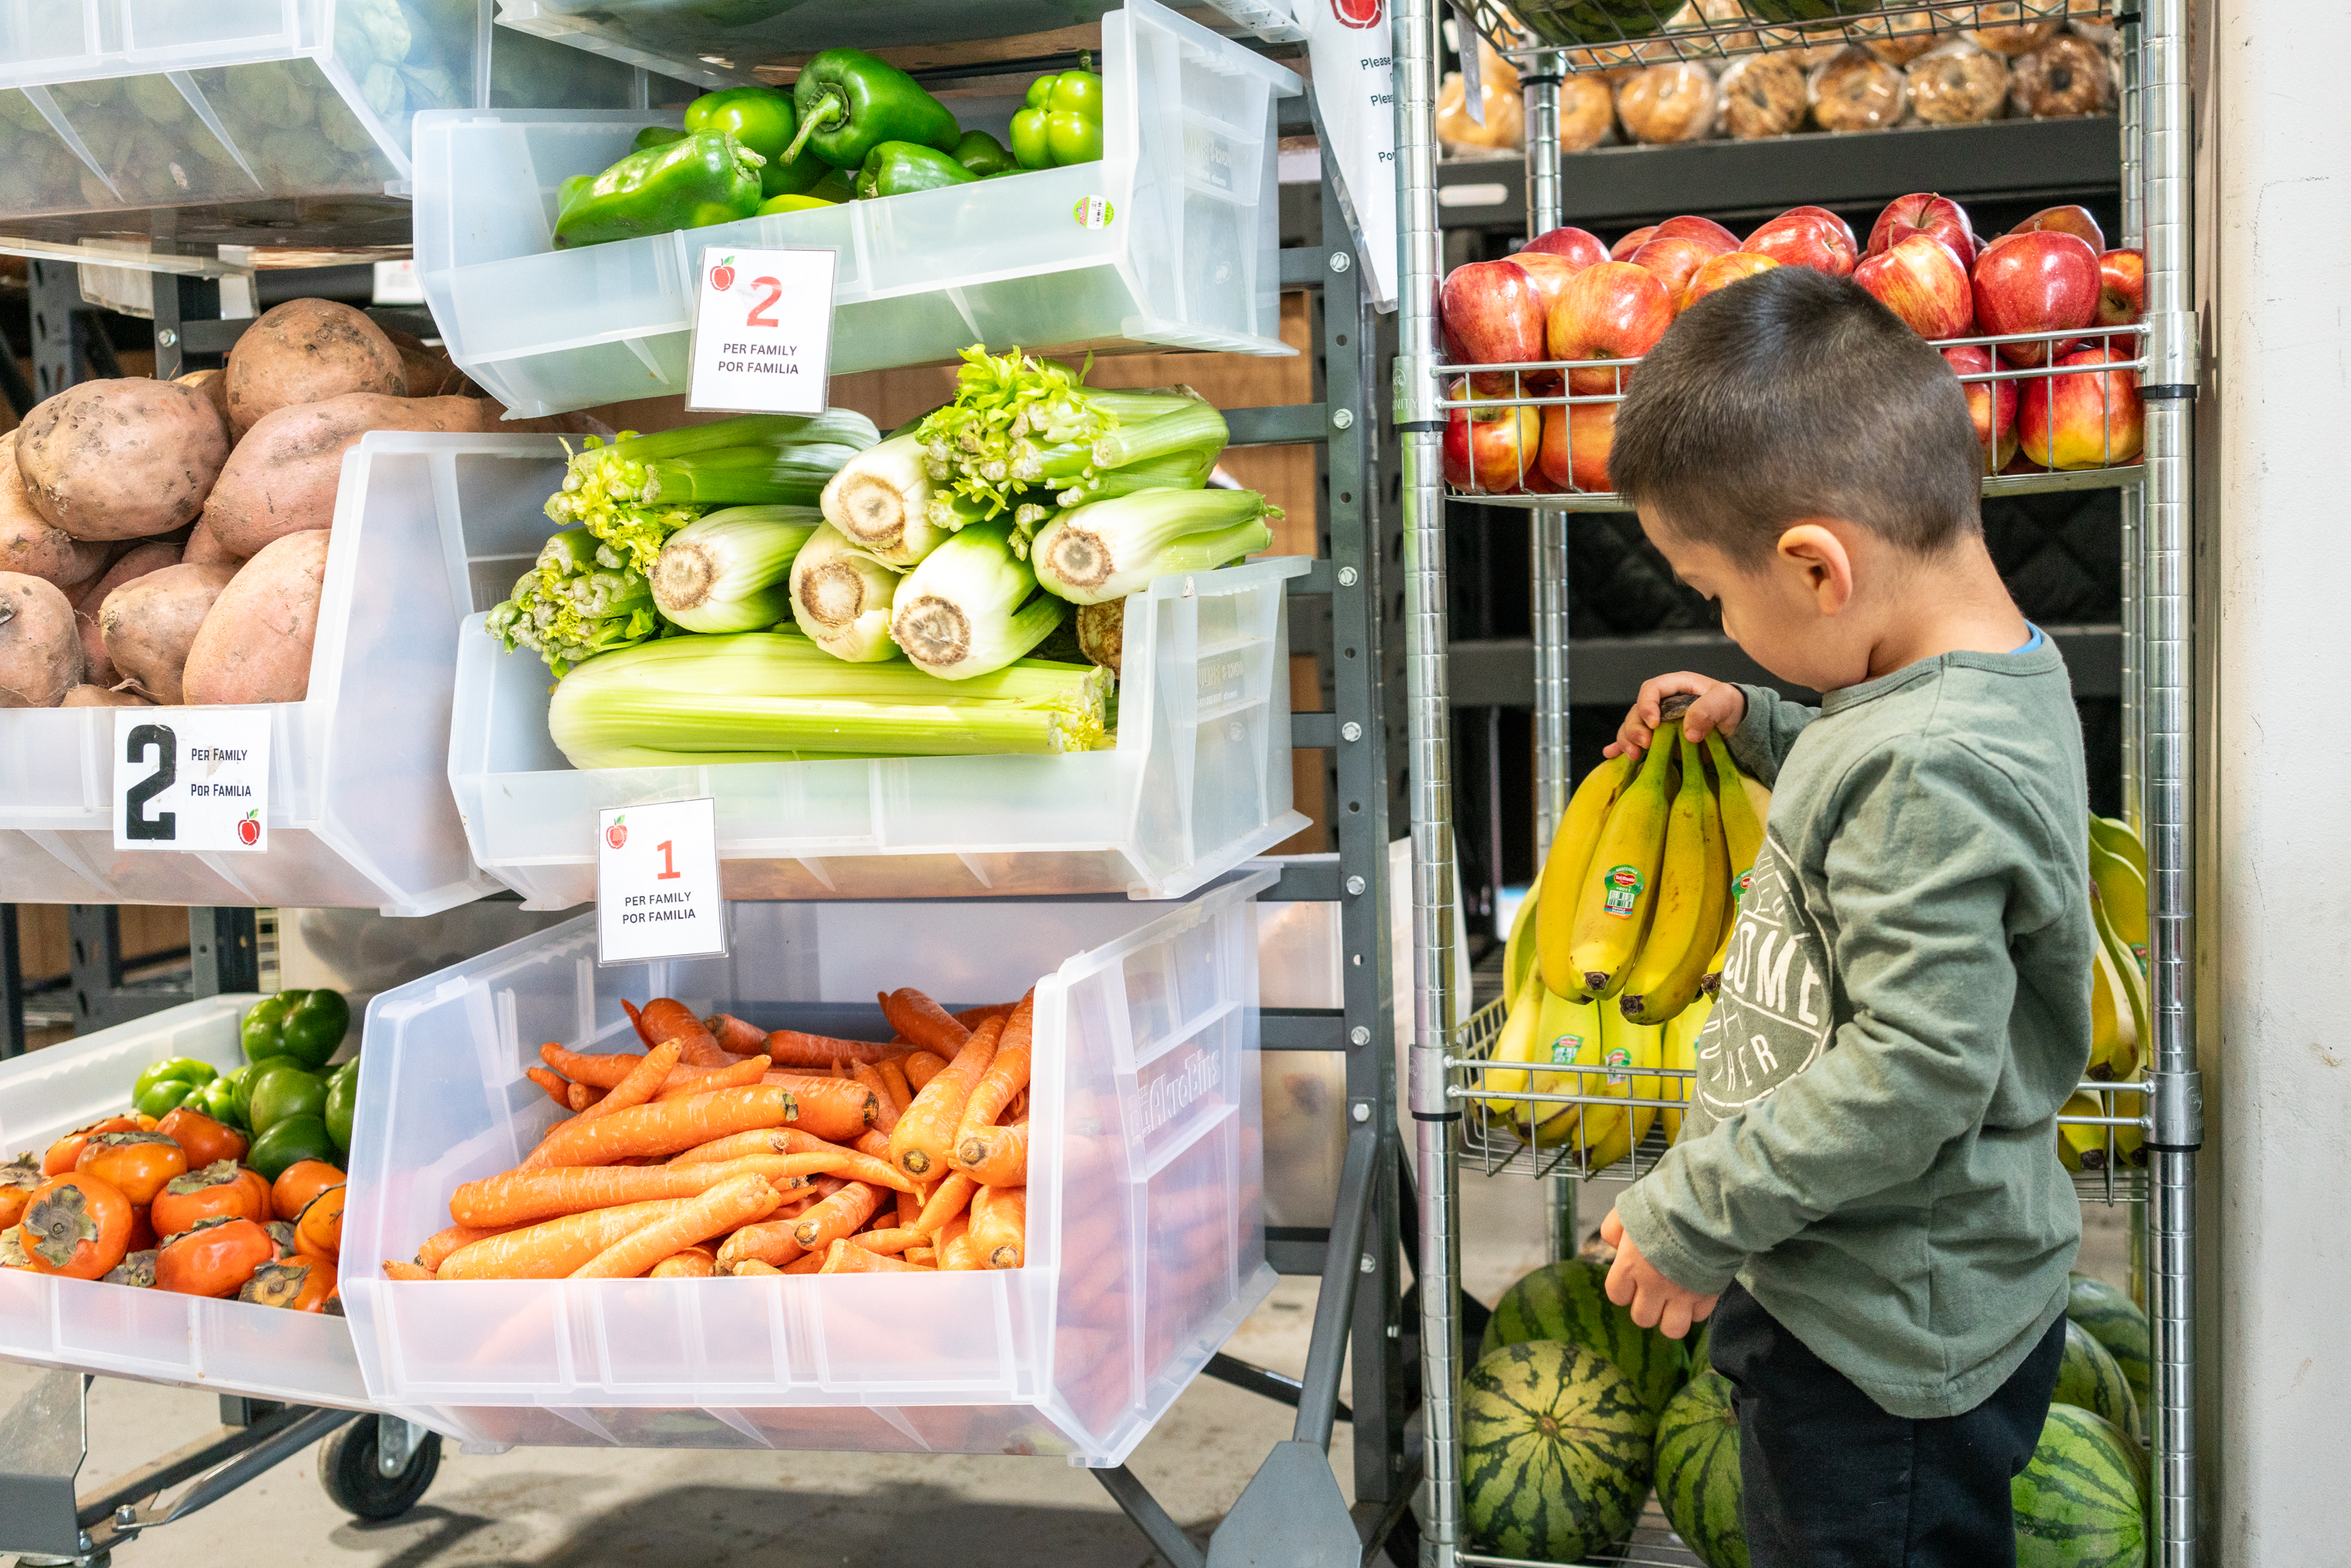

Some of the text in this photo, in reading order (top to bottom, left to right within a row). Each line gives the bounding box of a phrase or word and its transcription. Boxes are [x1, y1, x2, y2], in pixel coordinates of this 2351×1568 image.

[1360, 56, 1391, 70] Please
[746, 276, 783, 328] 2
[723, 343, 798, 356] PER FAMILY
[718, 361, 799, 375] POR FAMILIA
[126, 723, 177, 841] 2
[657, 839, 681, 880] 1
[1615, 867, 1638, 875] GUATEMALA
[625, 891, 691, 907] PER FAMILY
[622, 908, 696, 925] POR FAMILIA
